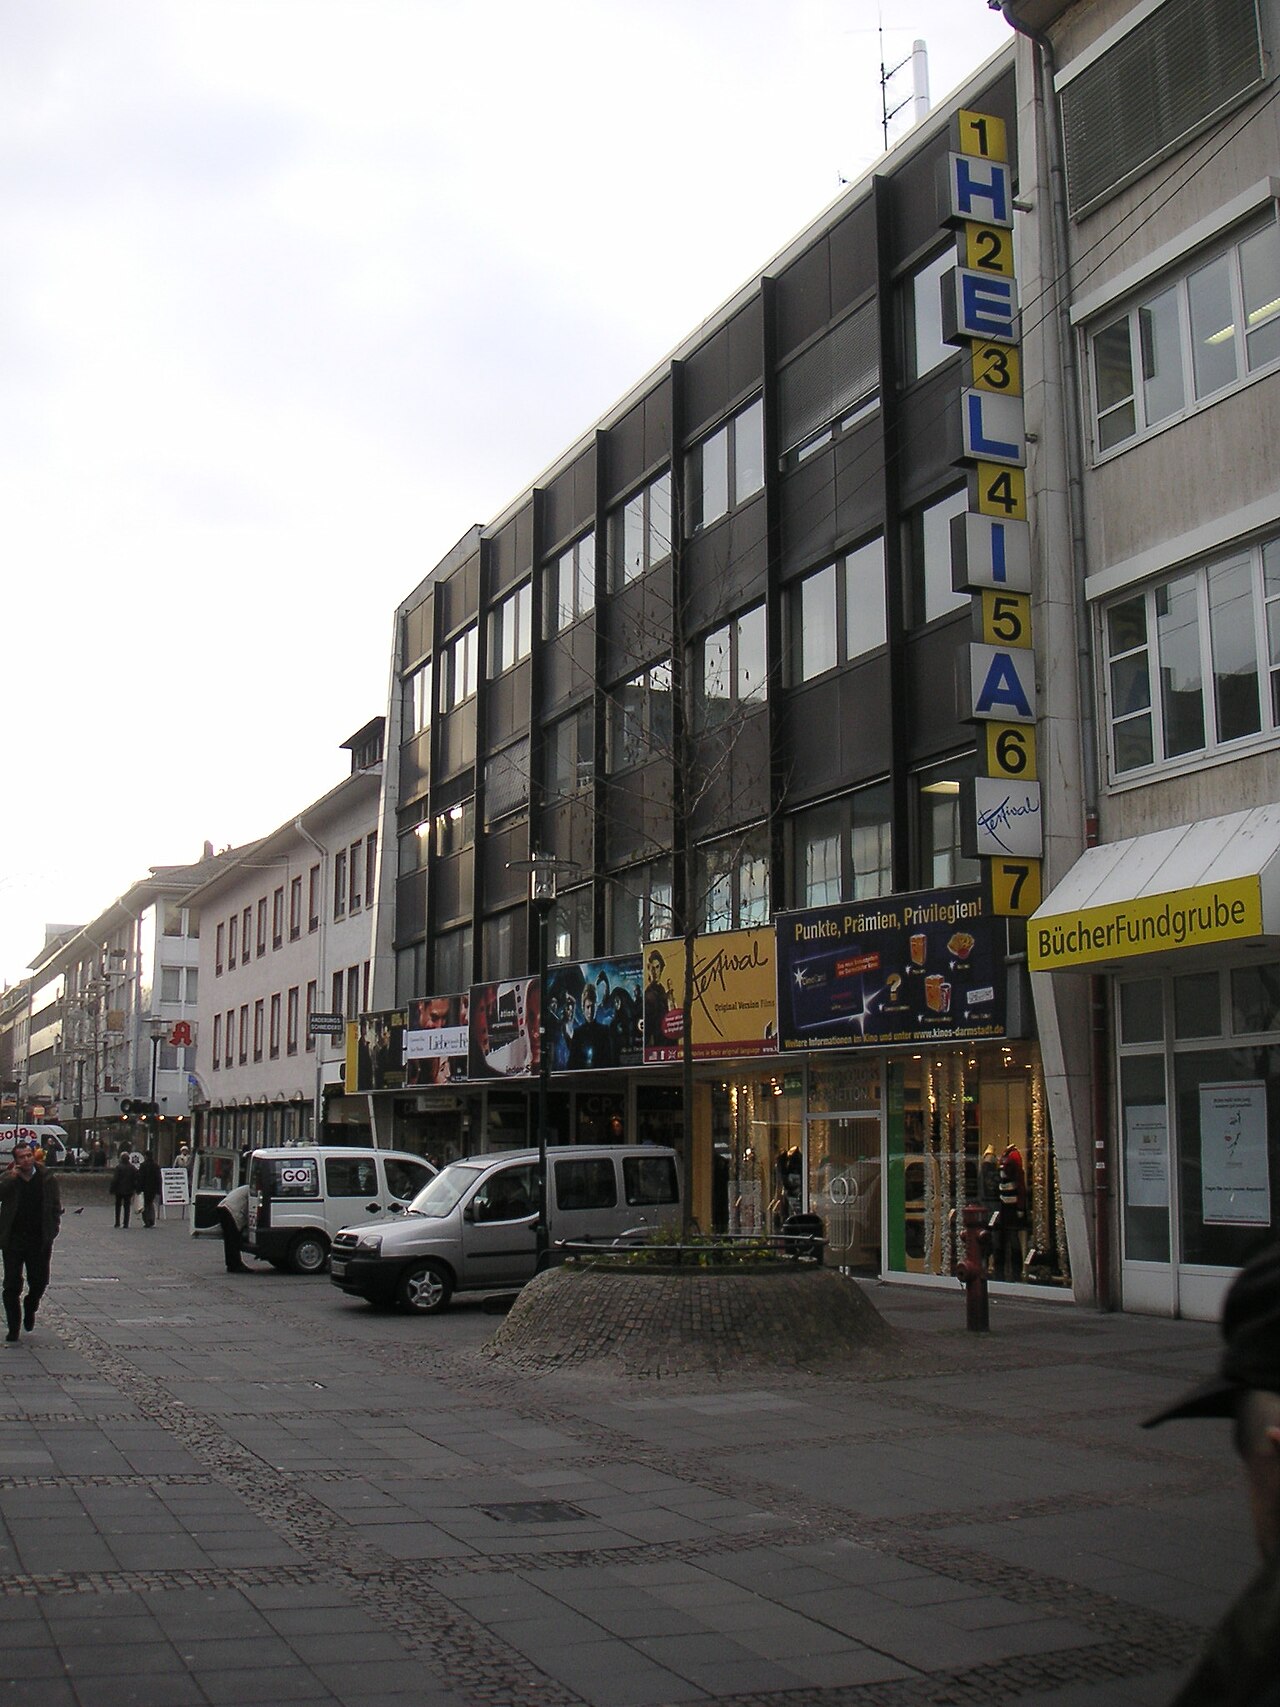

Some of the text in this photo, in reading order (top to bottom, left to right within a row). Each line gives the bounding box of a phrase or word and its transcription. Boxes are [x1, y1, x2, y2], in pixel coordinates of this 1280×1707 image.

[970, 118, 988, 156] 1
[976, 230, 1003, 270] 2
[983, 348, 1010, 388] 3
[987, 471, 1017, 514] 4
[992, 597, 1021, 642] 5
[996, 729, 1027, 774] 6
[978, 796, 1039, 854] Festival
[1003, 865, 1029, 908] 7
[794, 897, 982, 941] Punkte, Prämien, Privilegien!
[1039, 895, 1245, 957] BücherFundgrube
[692, 940, 768, 1037] Festival
[715, 1001, 737, 1012] Original
[739, 1001, 759, 1009] Version
[283, 1170, 310, 1182] GO!
